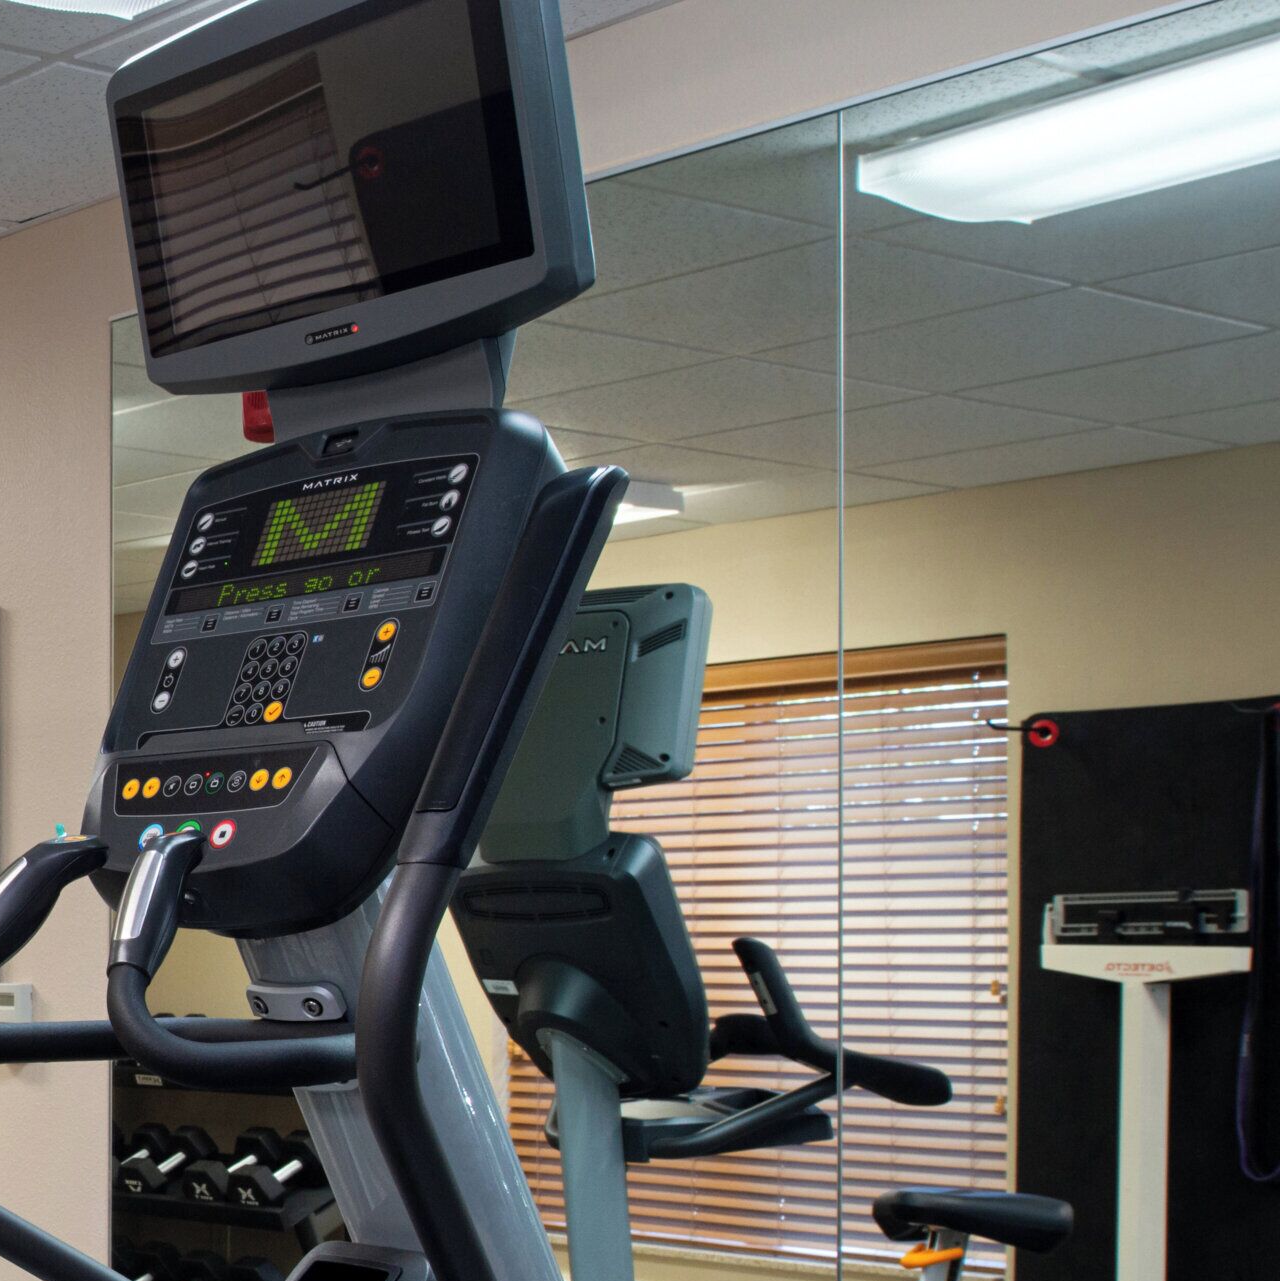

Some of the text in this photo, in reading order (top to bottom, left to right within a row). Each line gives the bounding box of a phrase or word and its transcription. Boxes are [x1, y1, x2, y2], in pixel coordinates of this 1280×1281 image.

[315, 327, 348, 340] MATRIX
[302, 473, 359, 491] MATRIX
[217, 583, 288, 607] Press
[348, 567, 380, 587] or
